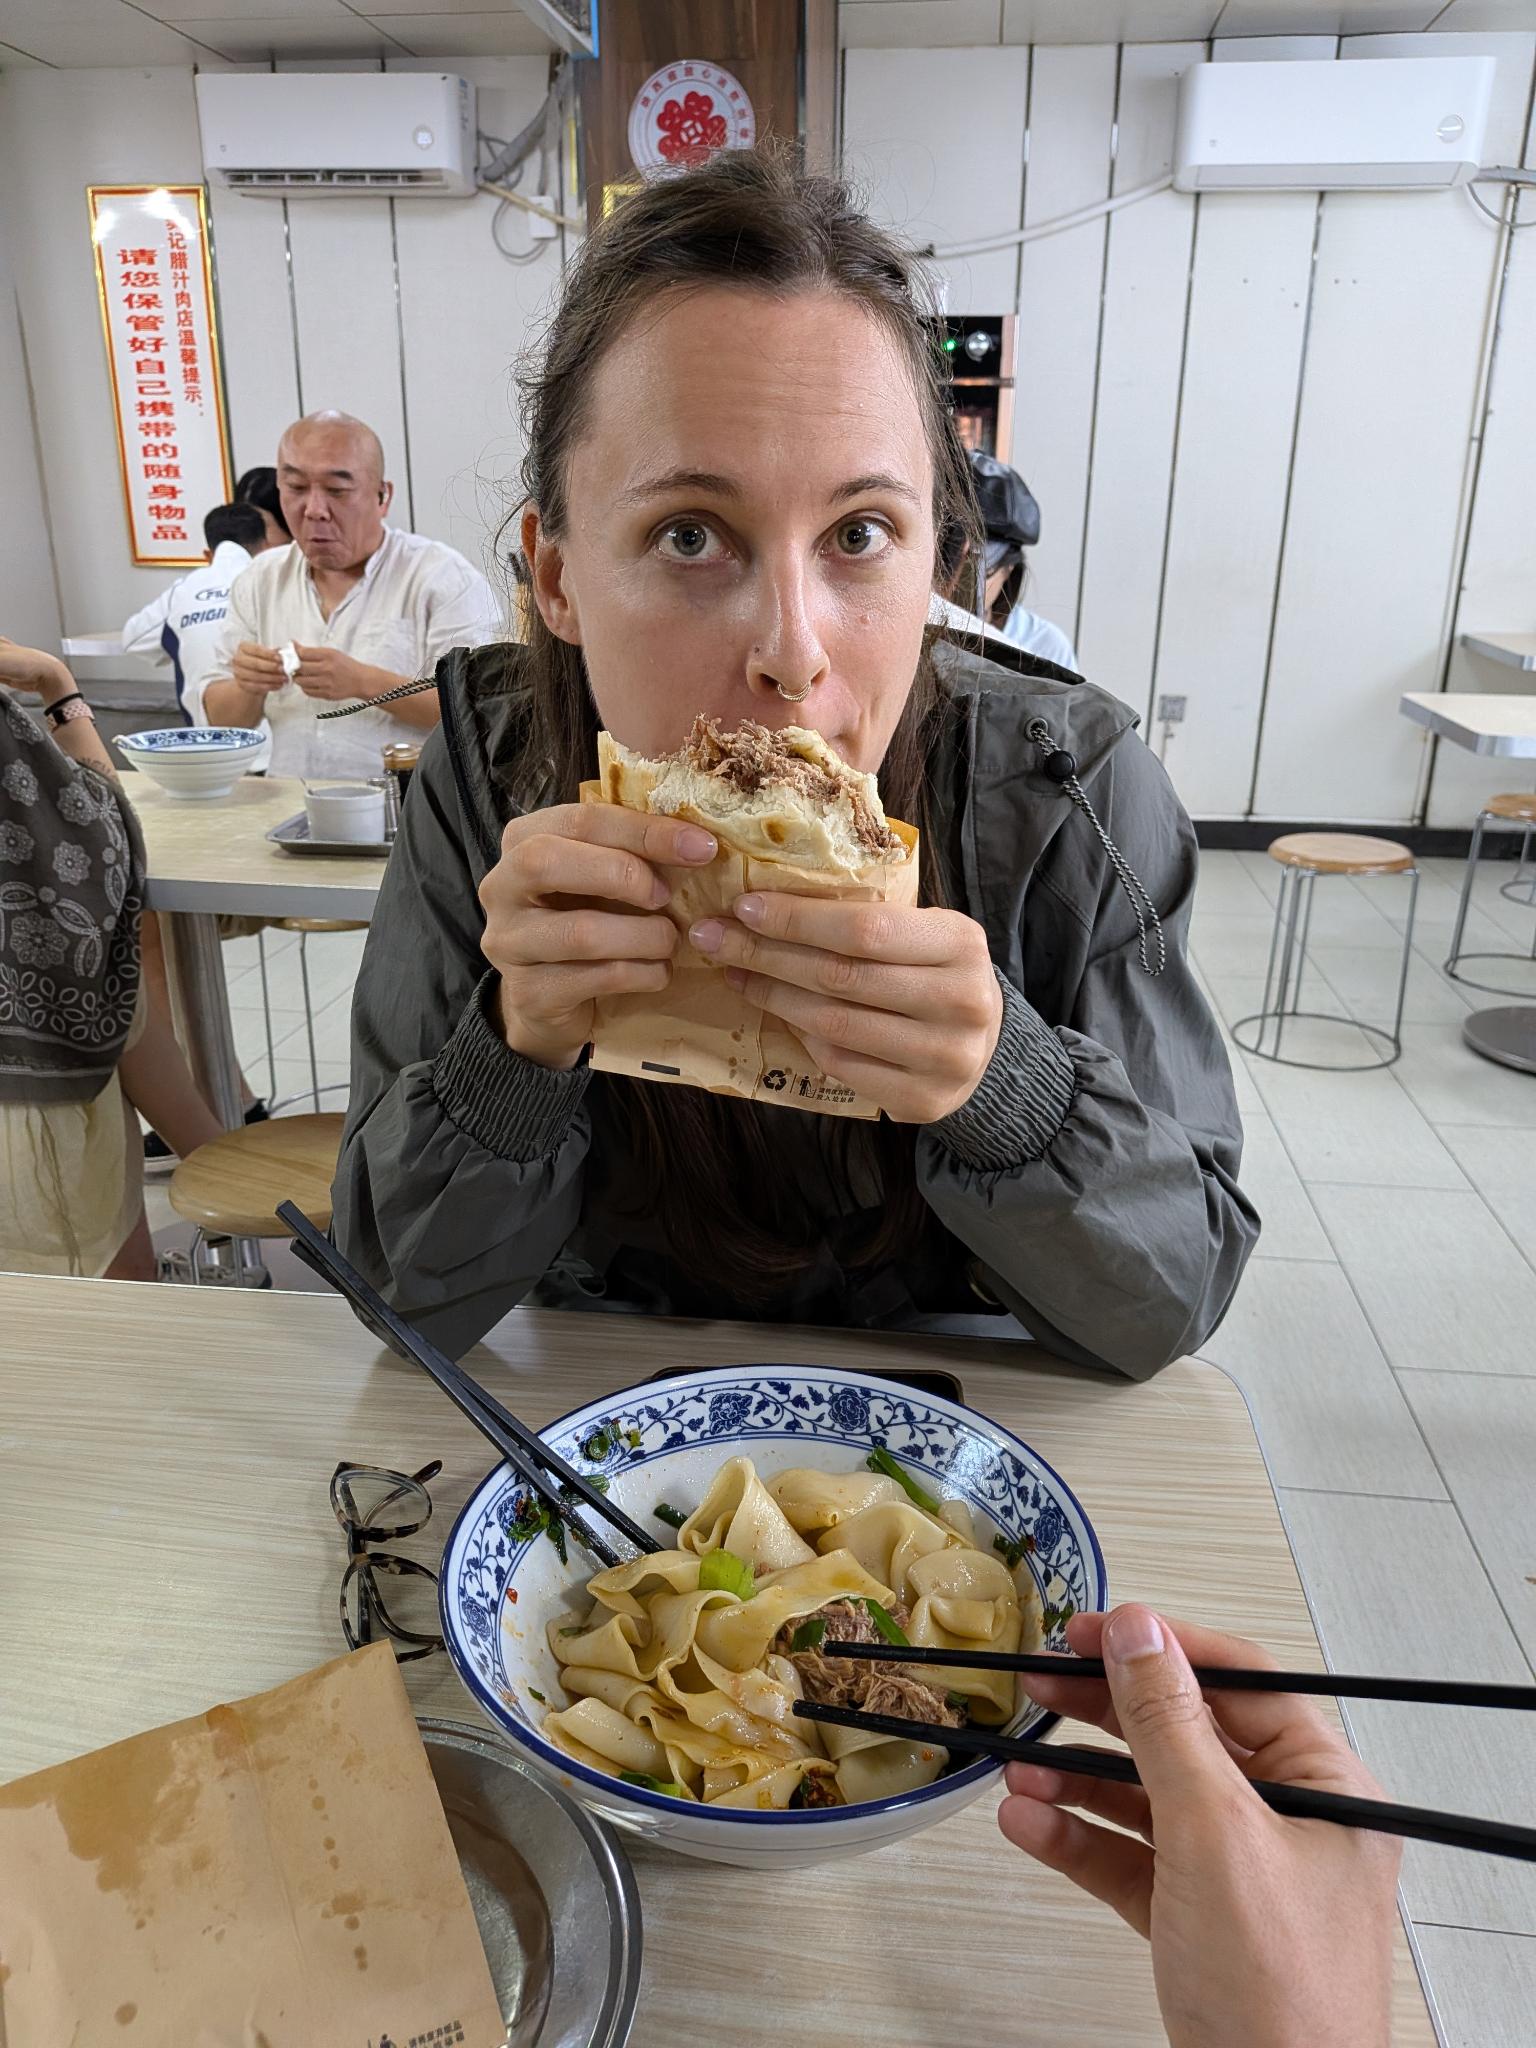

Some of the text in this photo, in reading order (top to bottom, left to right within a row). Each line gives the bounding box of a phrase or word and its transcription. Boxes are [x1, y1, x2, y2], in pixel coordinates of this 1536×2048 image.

[117, 248, 188, 541] 请您保管好自己携带的随身物品
